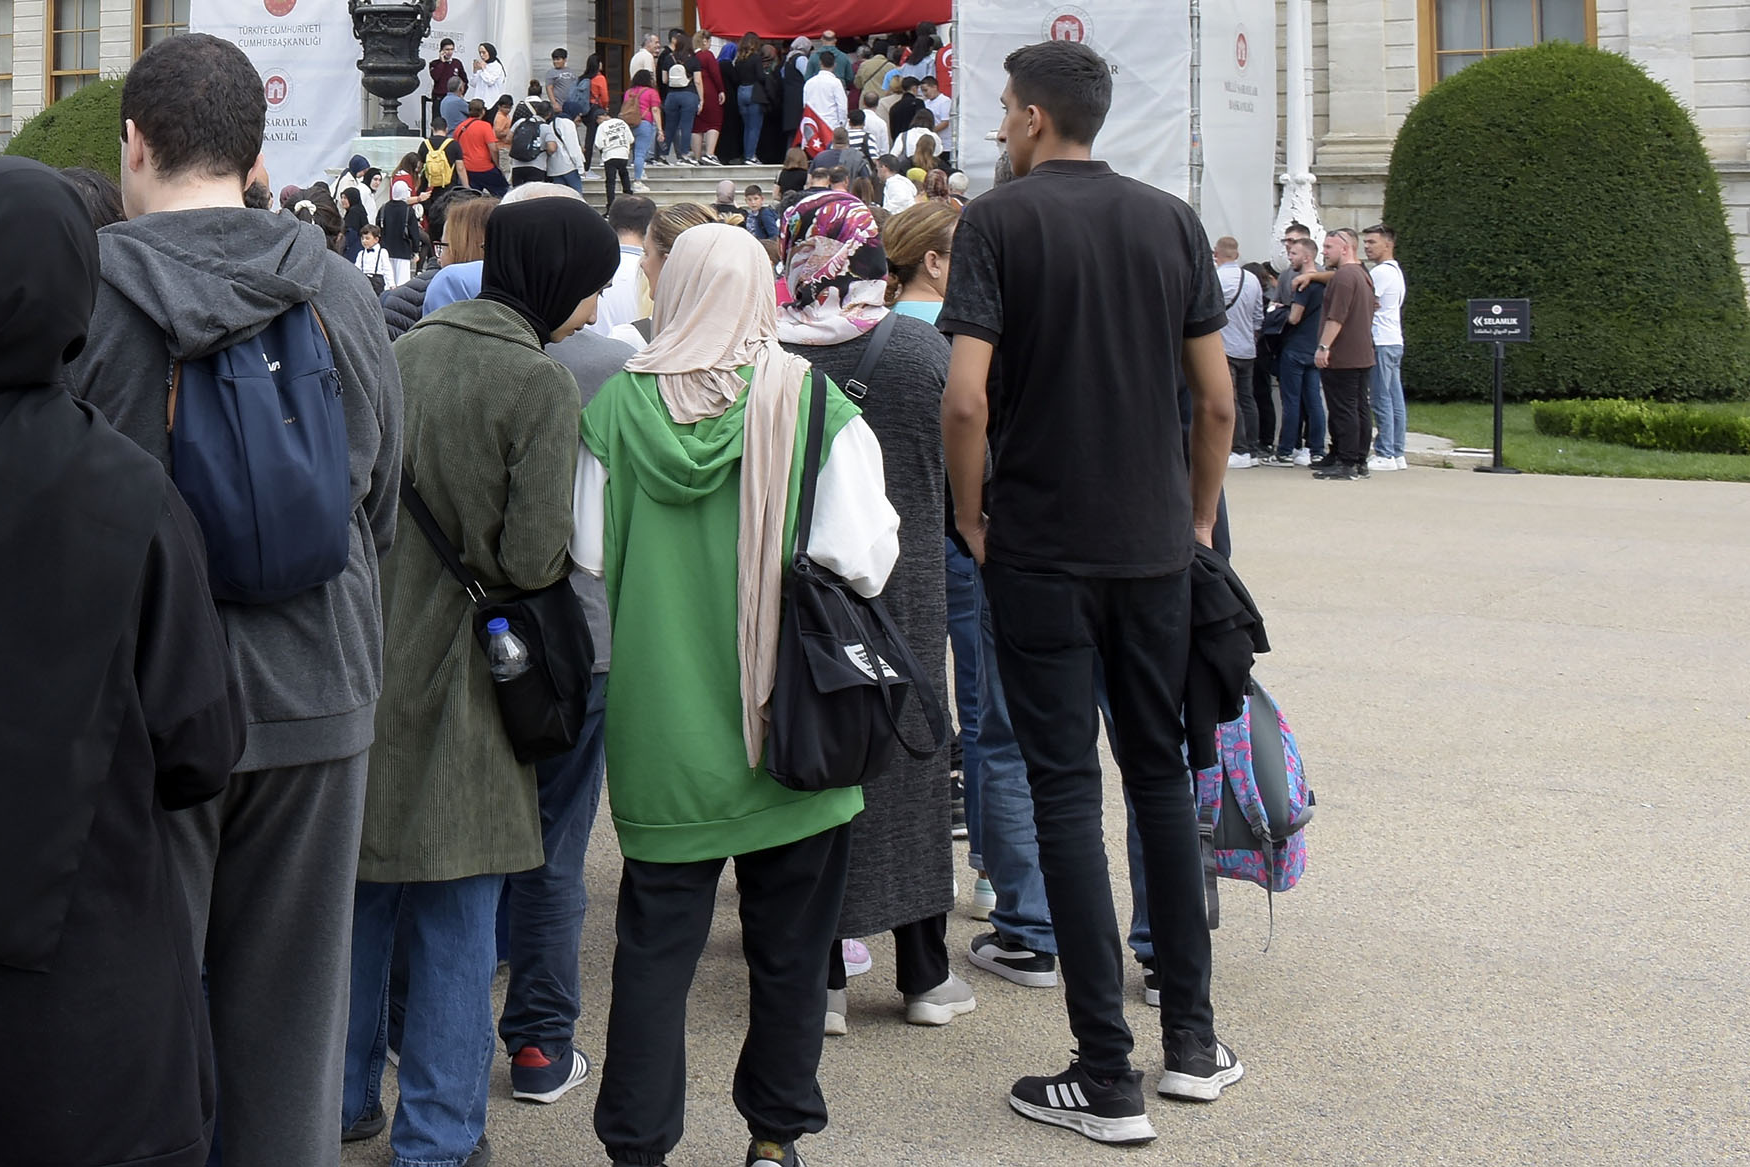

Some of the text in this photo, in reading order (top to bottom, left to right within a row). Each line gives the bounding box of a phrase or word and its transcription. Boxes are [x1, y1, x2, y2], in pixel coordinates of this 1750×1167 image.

[238, 23, 321, 35] TÜRKİYE CUMHURİYETİ
[238, 36, 321, 48] CUMHURBAŞKANLIĞI
[266, 118, 308, 127] SARAYLAR
[263, 131, 298, 142] KANLIĞI
